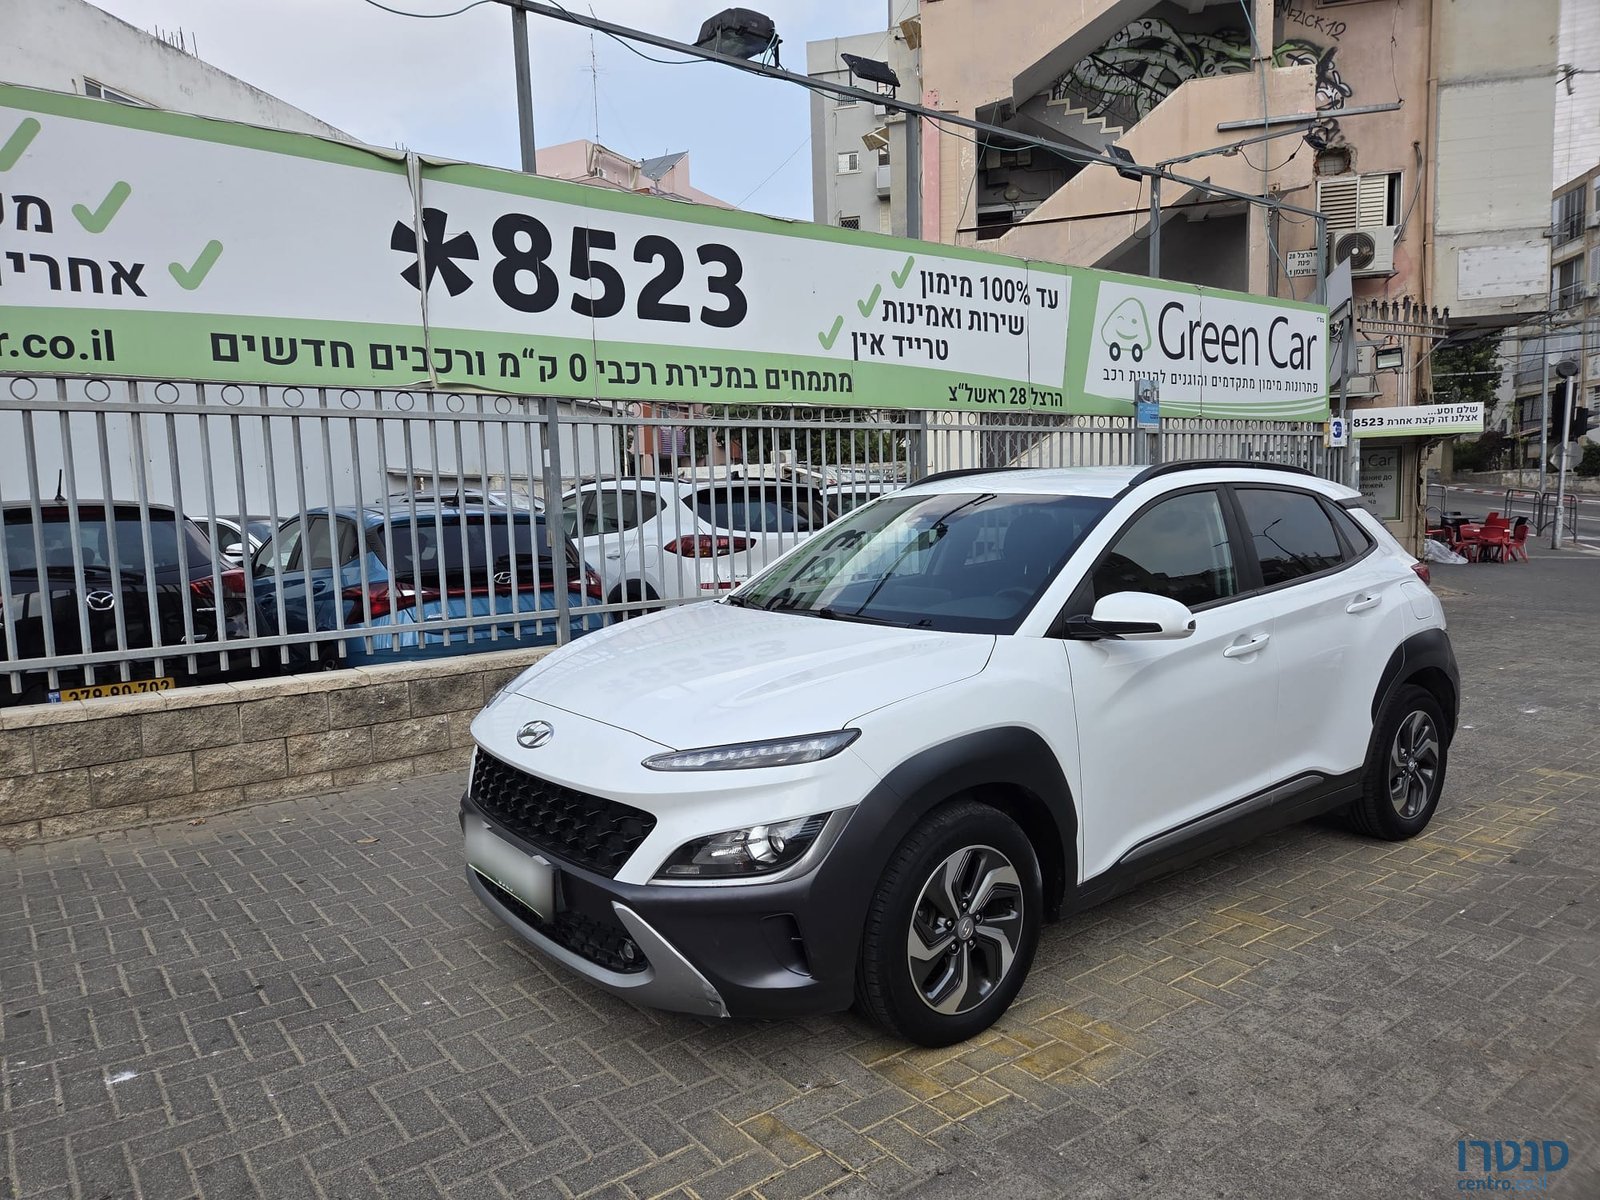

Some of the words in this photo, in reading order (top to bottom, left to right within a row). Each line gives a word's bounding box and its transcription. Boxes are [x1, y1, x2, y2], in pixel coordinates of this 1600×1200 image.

[0, 251, 148, 298] אחרי
[920, 270, 973, 299] מימון
[979, 275, 1032, 306] 100%
[1035, 287, 1059, 310] עד
[882, 299, 962, 329] ואמינות
[968, 309, 1025, 336] שירות
[851, 331, 885, 361] אין
[1158, 301, 1259, 366] Green
[1268, 316, 1318, 370] Car
[210, 332, 355, 369] חדשים
[370, 342, 486, 377] ורכבים
[891, 335, 949, 361] טרייד
[569, 353, 587, 382] 0
[596, 357, 657, 386] רכבי
[665, 363, 759, 390] במכירת
[1102, 368, 1125, 382] רכב
[765, 368, 854, 393] מתמחים
[1170, 372, 1208, 388] והוגנים
[1211, 375, 1257, 393] מתקדמים
[1258, 378, 1283, 393] מימון
[1284, 381, 1319, 394] פתרונות
[1009, 386, 1027, 405] 28
[1031, 387, 1063, 407] הרצל
[1414, 415, 1435, 425] קצת
[1438, 415, 1449, 423] זה
[1450, 412, 1479, 423] אצלנו
[1456, 404, 1479, 415] שלם
[1352, 417, 1385, 428] 8523
[1386, 417, 1412, 427] אחרת
[1368, 454, 1392, 467] Car
